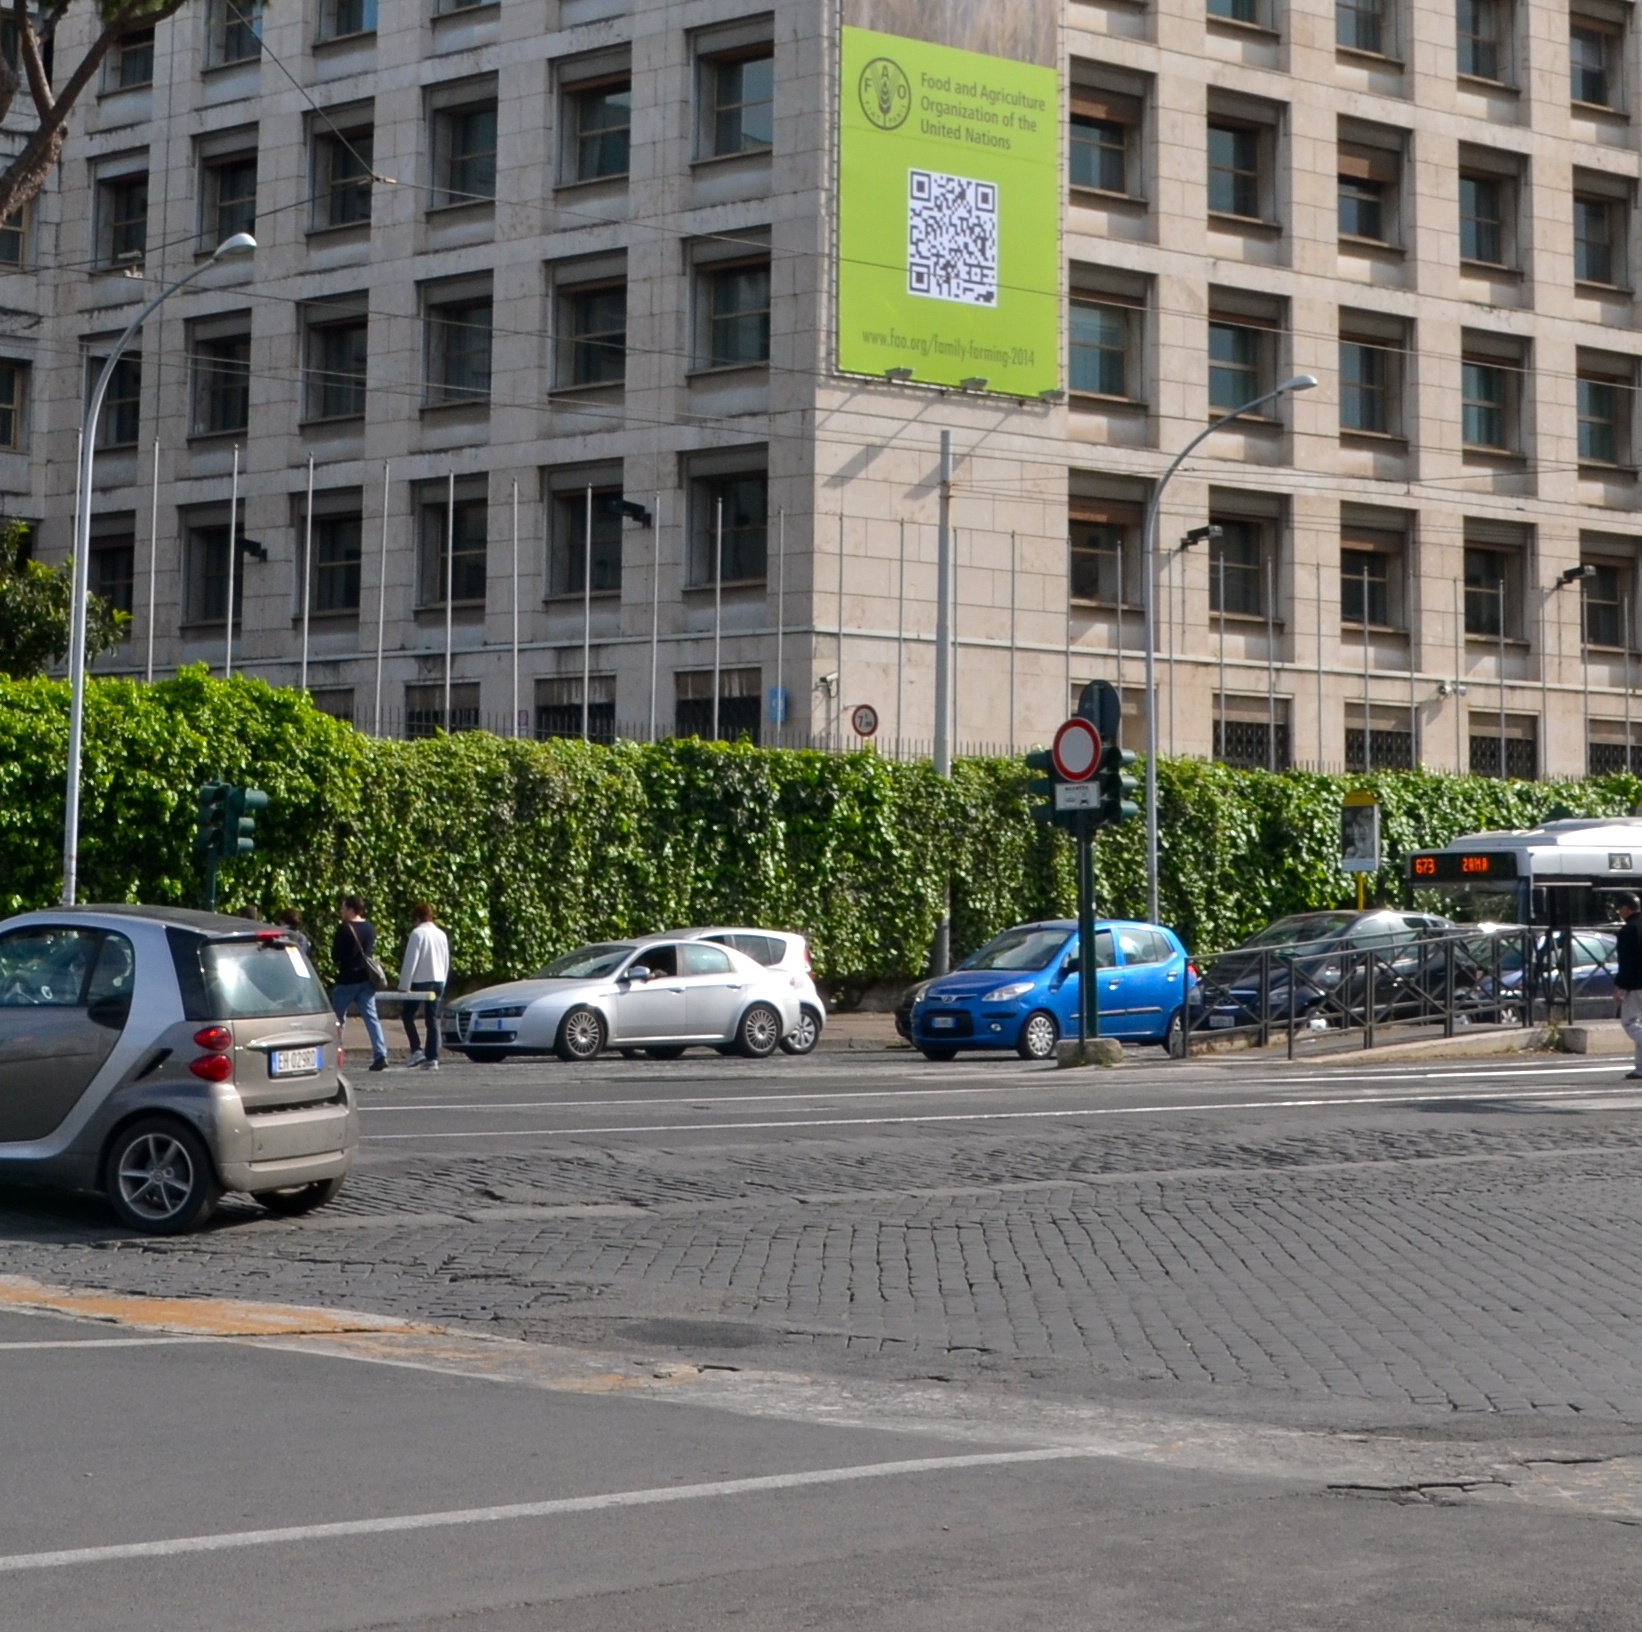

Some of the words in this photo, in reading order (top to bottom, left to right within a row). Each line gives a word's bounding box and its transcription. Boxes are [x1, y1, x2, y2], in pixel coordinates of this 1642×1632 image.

[921, 72, 951, 92] Food
[954, 82, 977, 98] and
[980, 85, 1046, 112] Agriculture
[921, 96, 999, 124] Organization
[1002, 111, 1015, 127] of
[1017, 114, 1038, 133] the
[921, 119, 961, 141] United
[965, 127, 1011, 151] Nations
[1415, 857, 1436, 875] 673
